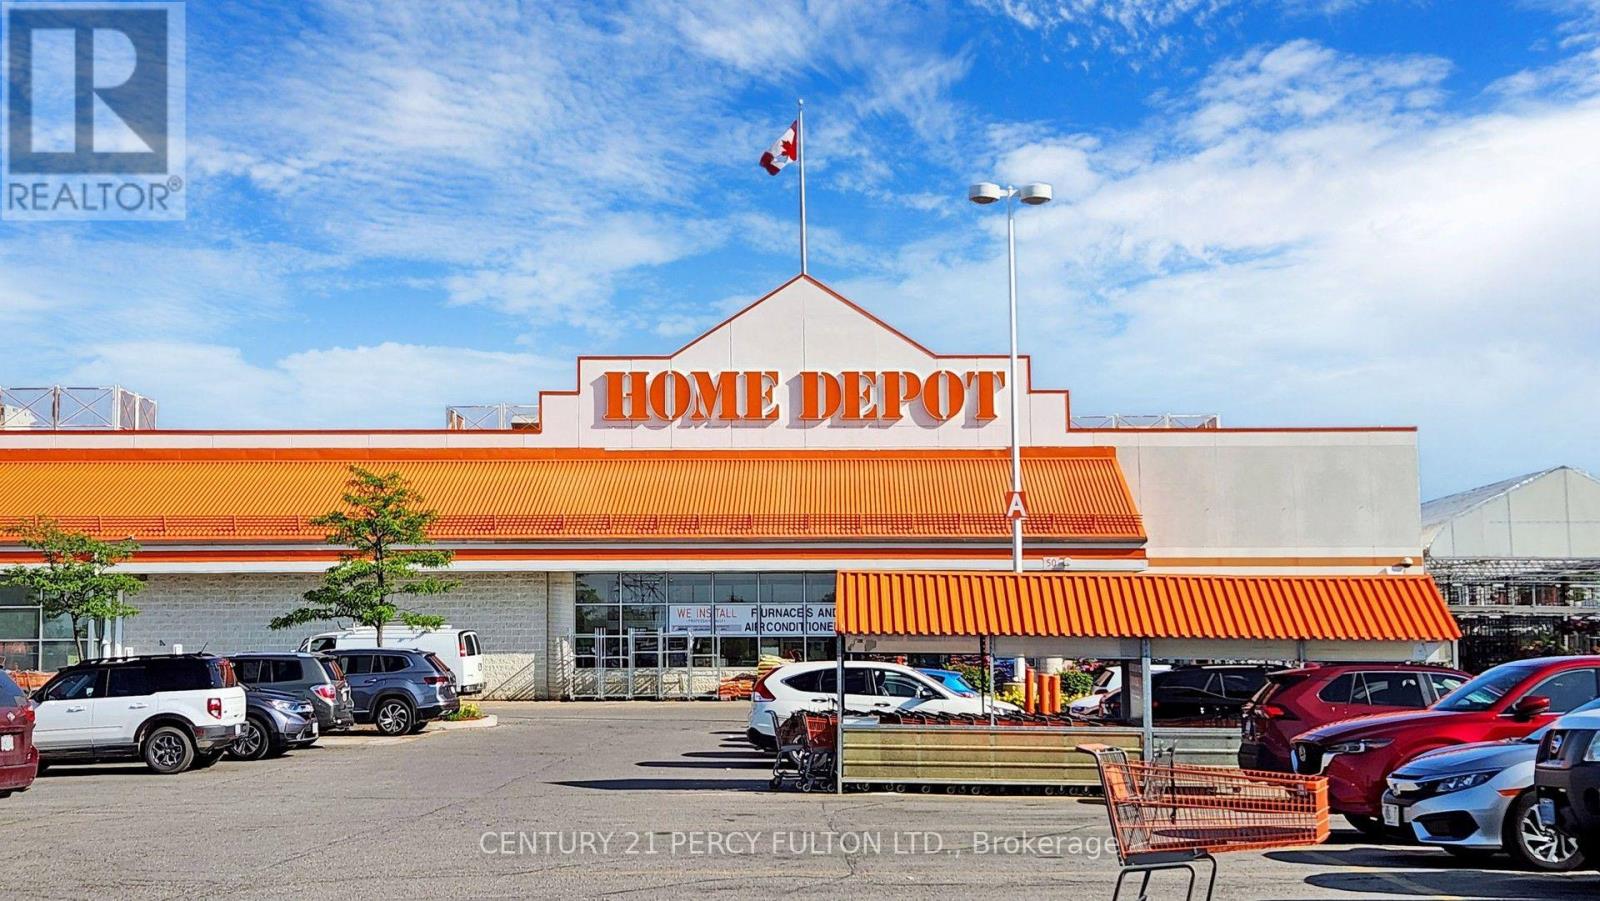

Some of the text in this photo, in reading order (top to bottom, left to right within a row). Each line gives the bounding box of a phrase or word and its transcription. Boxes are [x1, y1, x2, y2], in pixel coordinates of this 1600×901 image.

[603, 370, 1006, 421] HOME DEPOT
[1006, 492, 1027, 518] A
[677, 607, 737, 618] WE INSTALL
[751, 607, 814, 618] FURNACES
[744, 621, 836, 632] AIRCONDITIONE
